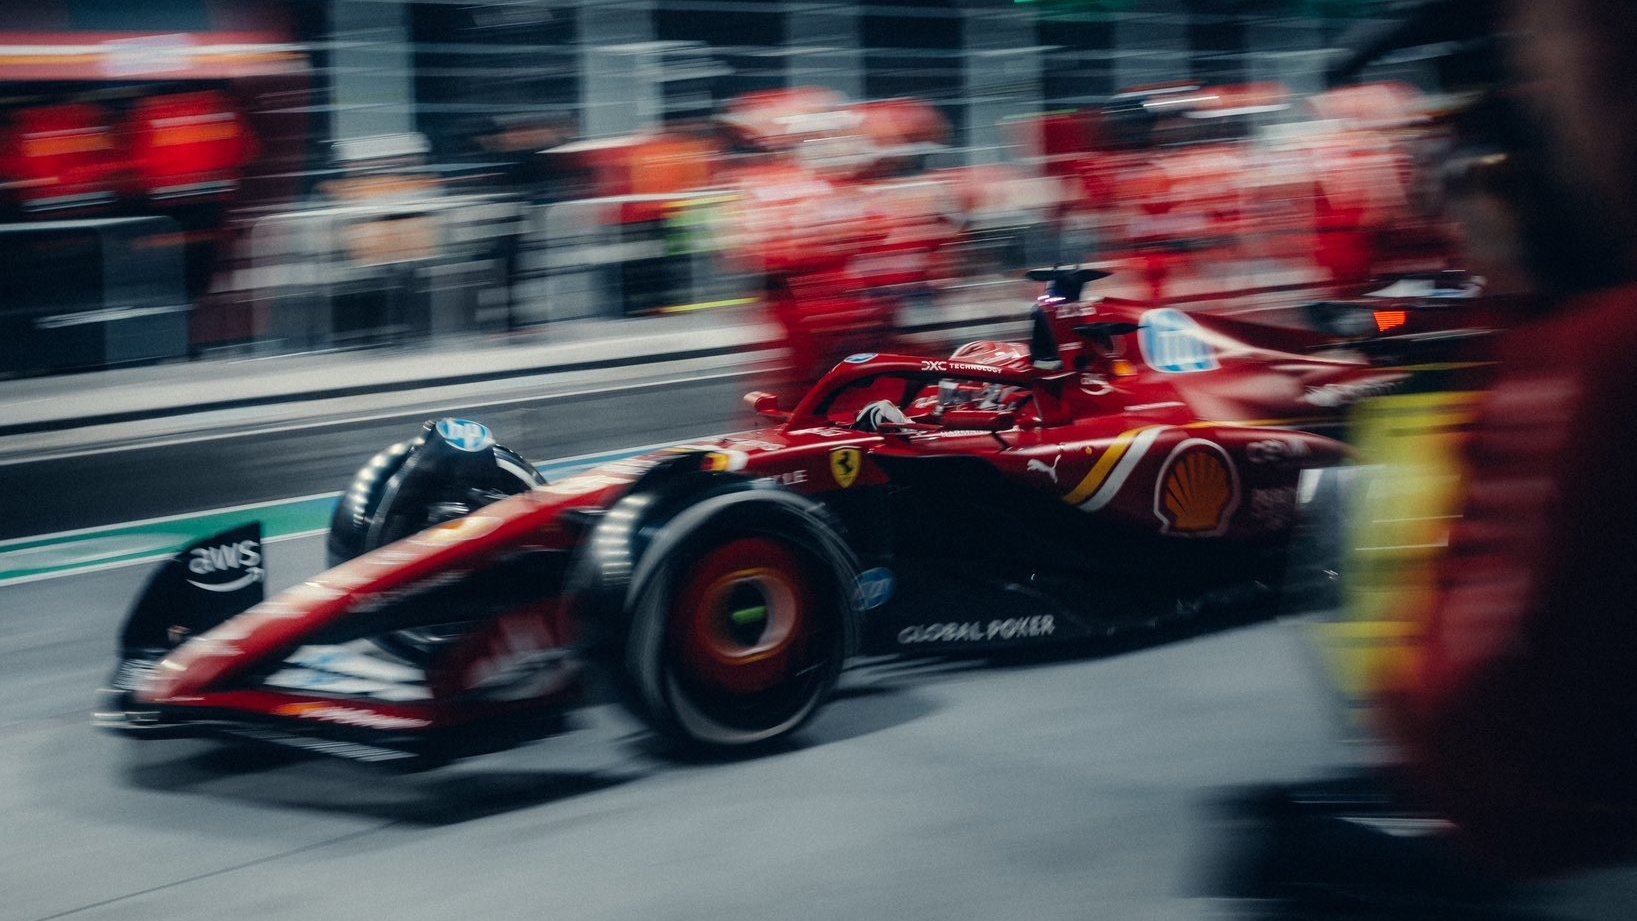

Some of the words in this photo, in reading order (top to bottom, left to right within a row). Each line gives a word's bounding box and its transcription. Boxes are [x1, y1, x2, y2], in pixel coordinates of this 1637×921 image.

[921, 361, 947, 371] DXC
[949, 363, 1002, 373] TECHNOLOGY
[189, 540, 260, 575] aws
[898, 621, 985, 644] GLOBAL
[987, 614, 1056, 641] POKER
